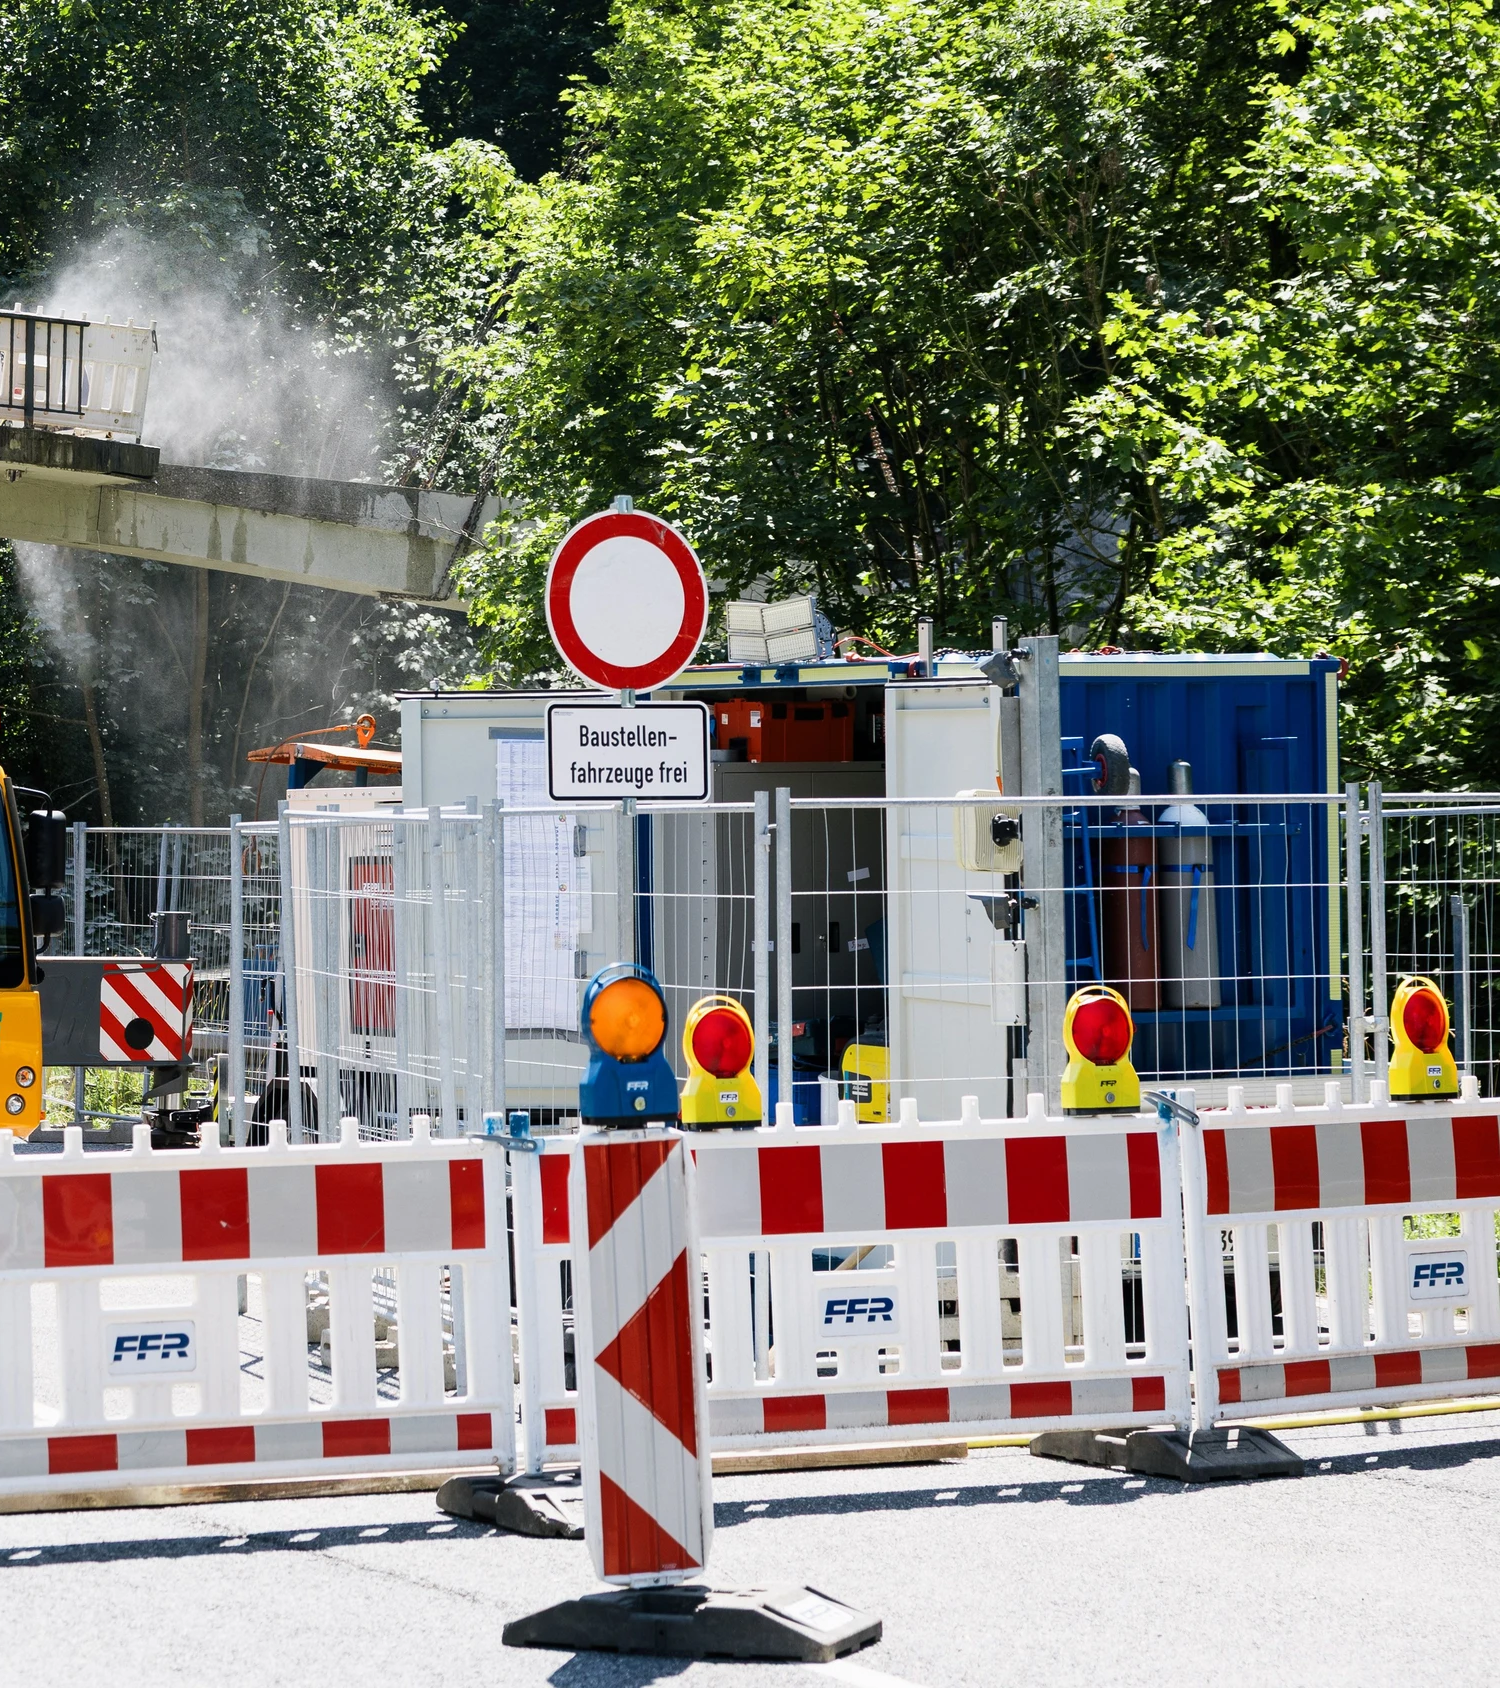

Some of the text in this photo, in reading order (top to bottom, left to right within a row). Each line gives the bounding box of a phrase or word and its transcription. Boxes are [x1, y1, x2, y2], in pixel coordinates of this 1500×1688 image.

[579, 725, 677, 747] Baustellen-
[570, 761, 688, 789] fahrzeuge frei
[626, 1081, 649, 1091] FFR
[720, 1093, 738, 1101] FFR
[1413, 1262, 1465, 1288] FFR
[824, 1297, 894, 1325] FFR
[112, 1332, 190, 1362] FFR
